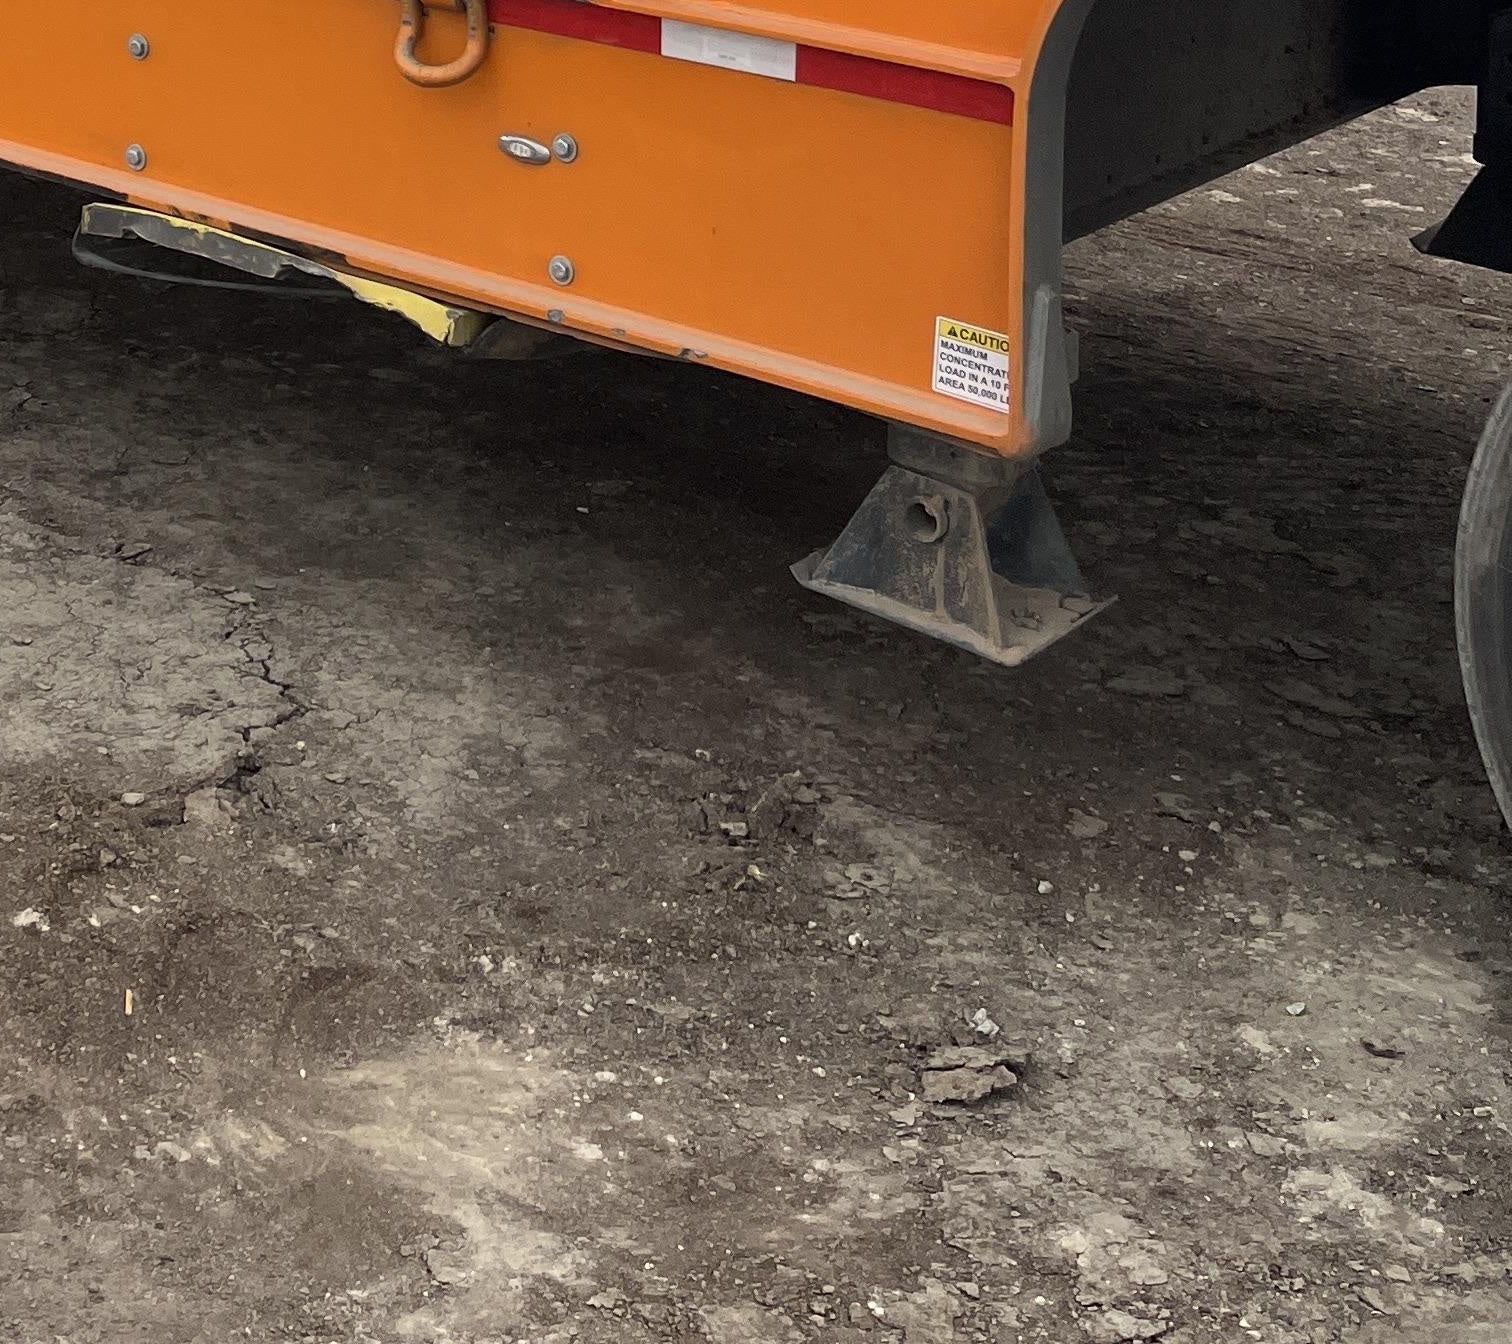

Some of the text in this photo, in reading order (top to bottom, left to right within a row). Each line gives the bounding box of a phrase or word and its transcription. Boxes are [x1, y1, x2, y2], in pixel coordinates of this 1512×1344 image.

[940, 339, 988, 361] MAXIMUM
[939, 351, 1009, 380] CONCENTRAT
[939, 363, 967, 379] LOAD
[968, 372, 979, 383] IN
[980, 376, 988, 386] A
[990, 379, 1002, 390] 10
[938, 375, 966, 392] AREA
[999, 394, 1010, 405] L
